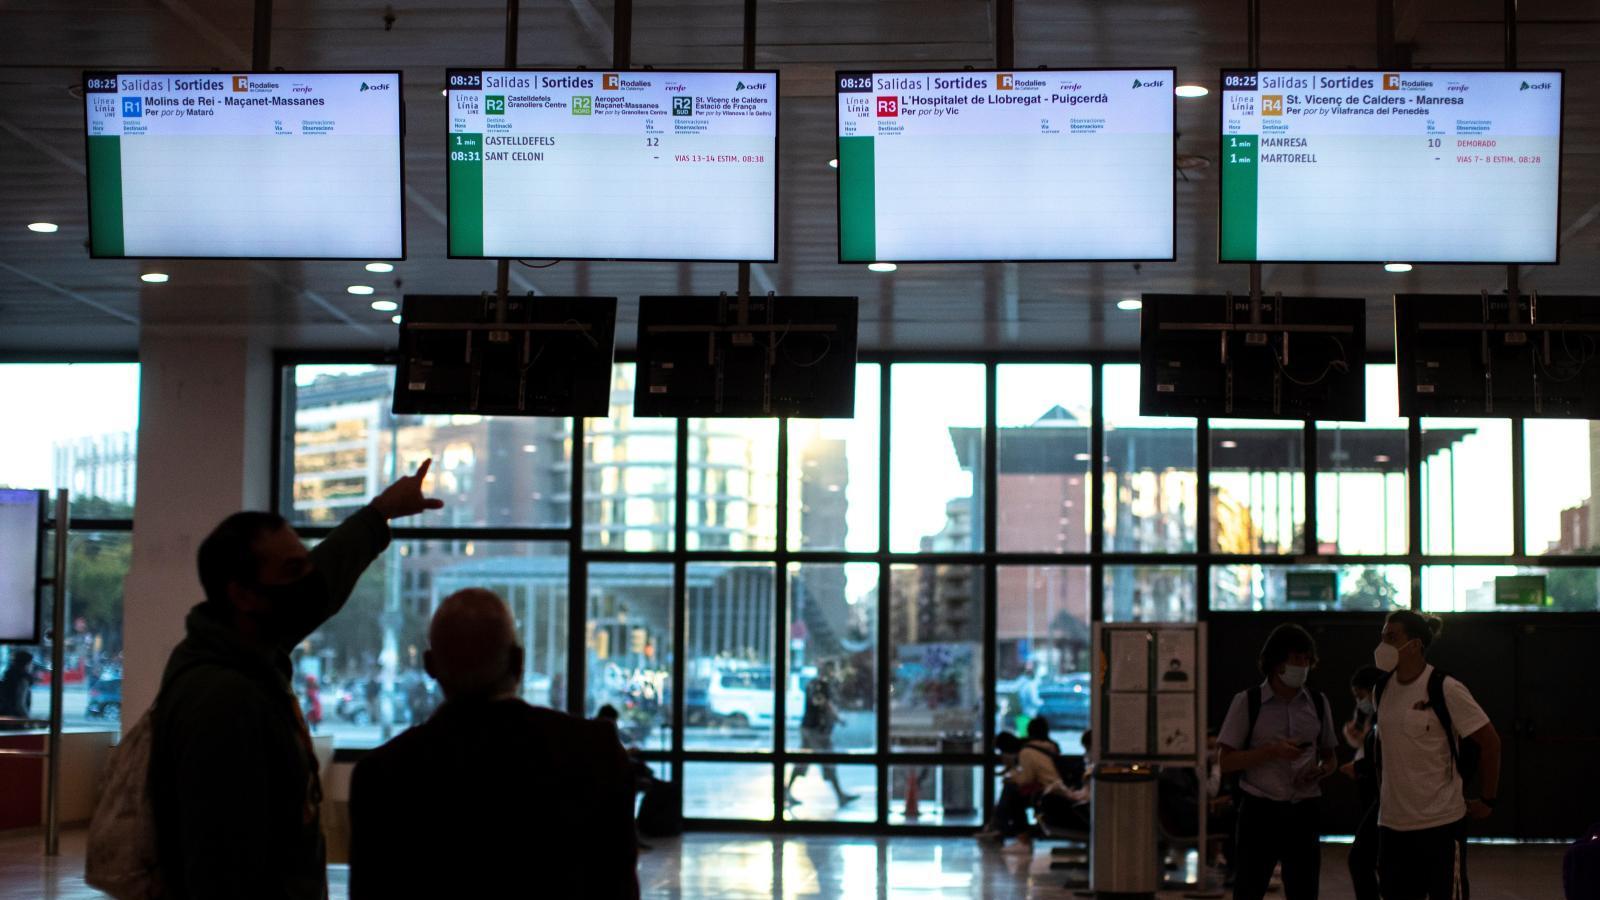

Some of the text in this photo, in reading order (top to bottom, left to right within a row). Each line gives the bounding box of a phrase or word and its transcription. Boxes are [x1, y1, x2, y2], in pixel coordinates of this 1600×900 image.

[88, 79, 116, 88] 08:25
[122, 79, 224, 90] Salidas Sortides
[451, 76, 480, 85] 08:25
[487, 76, 593, 88] Salidas Sortides
[841, 78, 871, 88] 08:26
[877, 78, 987, 90] Salidas Sortides
[1226, 76, 1256, 86] 08:25
[1263, 77, 1374, 88] Salidas Sortides
[665, 84, 686, 92] renfe
[145, 97, 179, 106] Molins
[183, 97, 195, 106] de
[198, 97, 214, 106] Rei
[224, 97, 325, 108] Maçanet-Massanes
[487, 100, 503, 110] R2
[574, 98, 590, 108] R2
[674, 98, 690, 109] R2
[902, 96, 967, 106] L'Hospitalet
[971, 95, 984, 104] de
[988, 95, 1041, 106] Llobregat
[1052, 94, 1108, 105] Puigcerdà
[1287, 95, 1301, 104] St.
[1305, 95, 1342, 106] Vicenç
[1346, 95, 1359, 104] de
[1363, 95, 1405, 104] Calders
[1416, 96, 1464, 104] Manresa
[125, 102, 140, 112] R1
[878, 101, 896, 112] R3
[1263, 100, 1281, 111] R4
[176, 109, 185, 117] by
[457, 136, 462, 145] 1
[485, 136, 555, 145] CASTELLDEFELS
[646, 138, 659, 146] 12
[1230, 138, 1237, 147] 1
[1261, 138, 1307, 147] MANRESA
[1428, 139, 1441, 147] 10
[452, 152, 480, 161] 08:31
[485, 152, 544, 161] SANT CELONI
[1230, 154, 1237, 163] 1
[1261, 154, 1317, 162] MARTORELL
